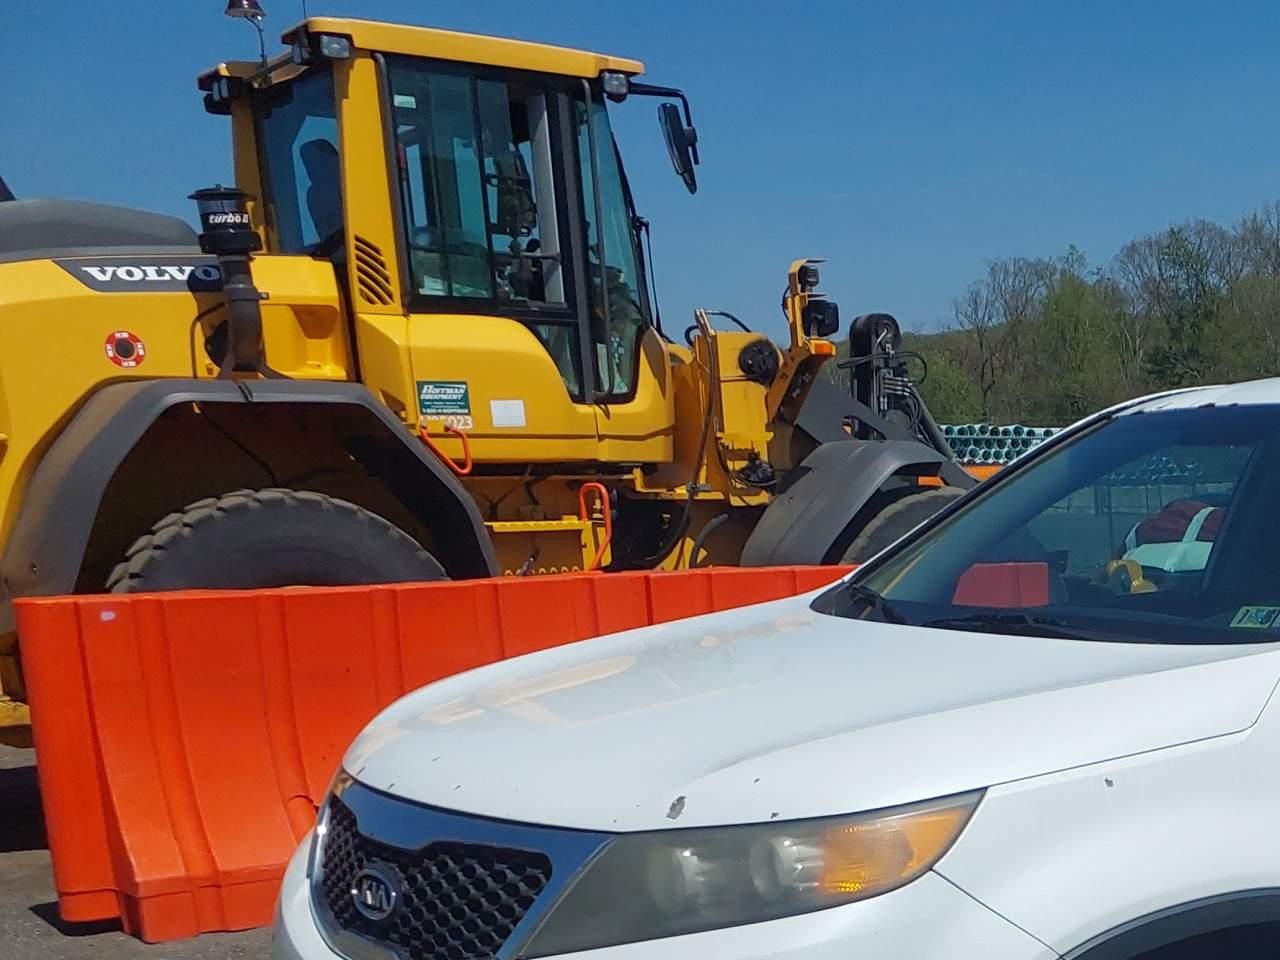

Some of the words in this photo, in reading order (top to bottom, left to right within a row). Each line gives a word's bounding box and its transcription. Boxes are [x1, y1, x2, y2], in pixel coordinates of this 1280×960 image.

[209, 212, 241, 224] turbo
[81, 265, 220, 282] VOLVO
[421, 384, 467, 395] HOFFMAN
